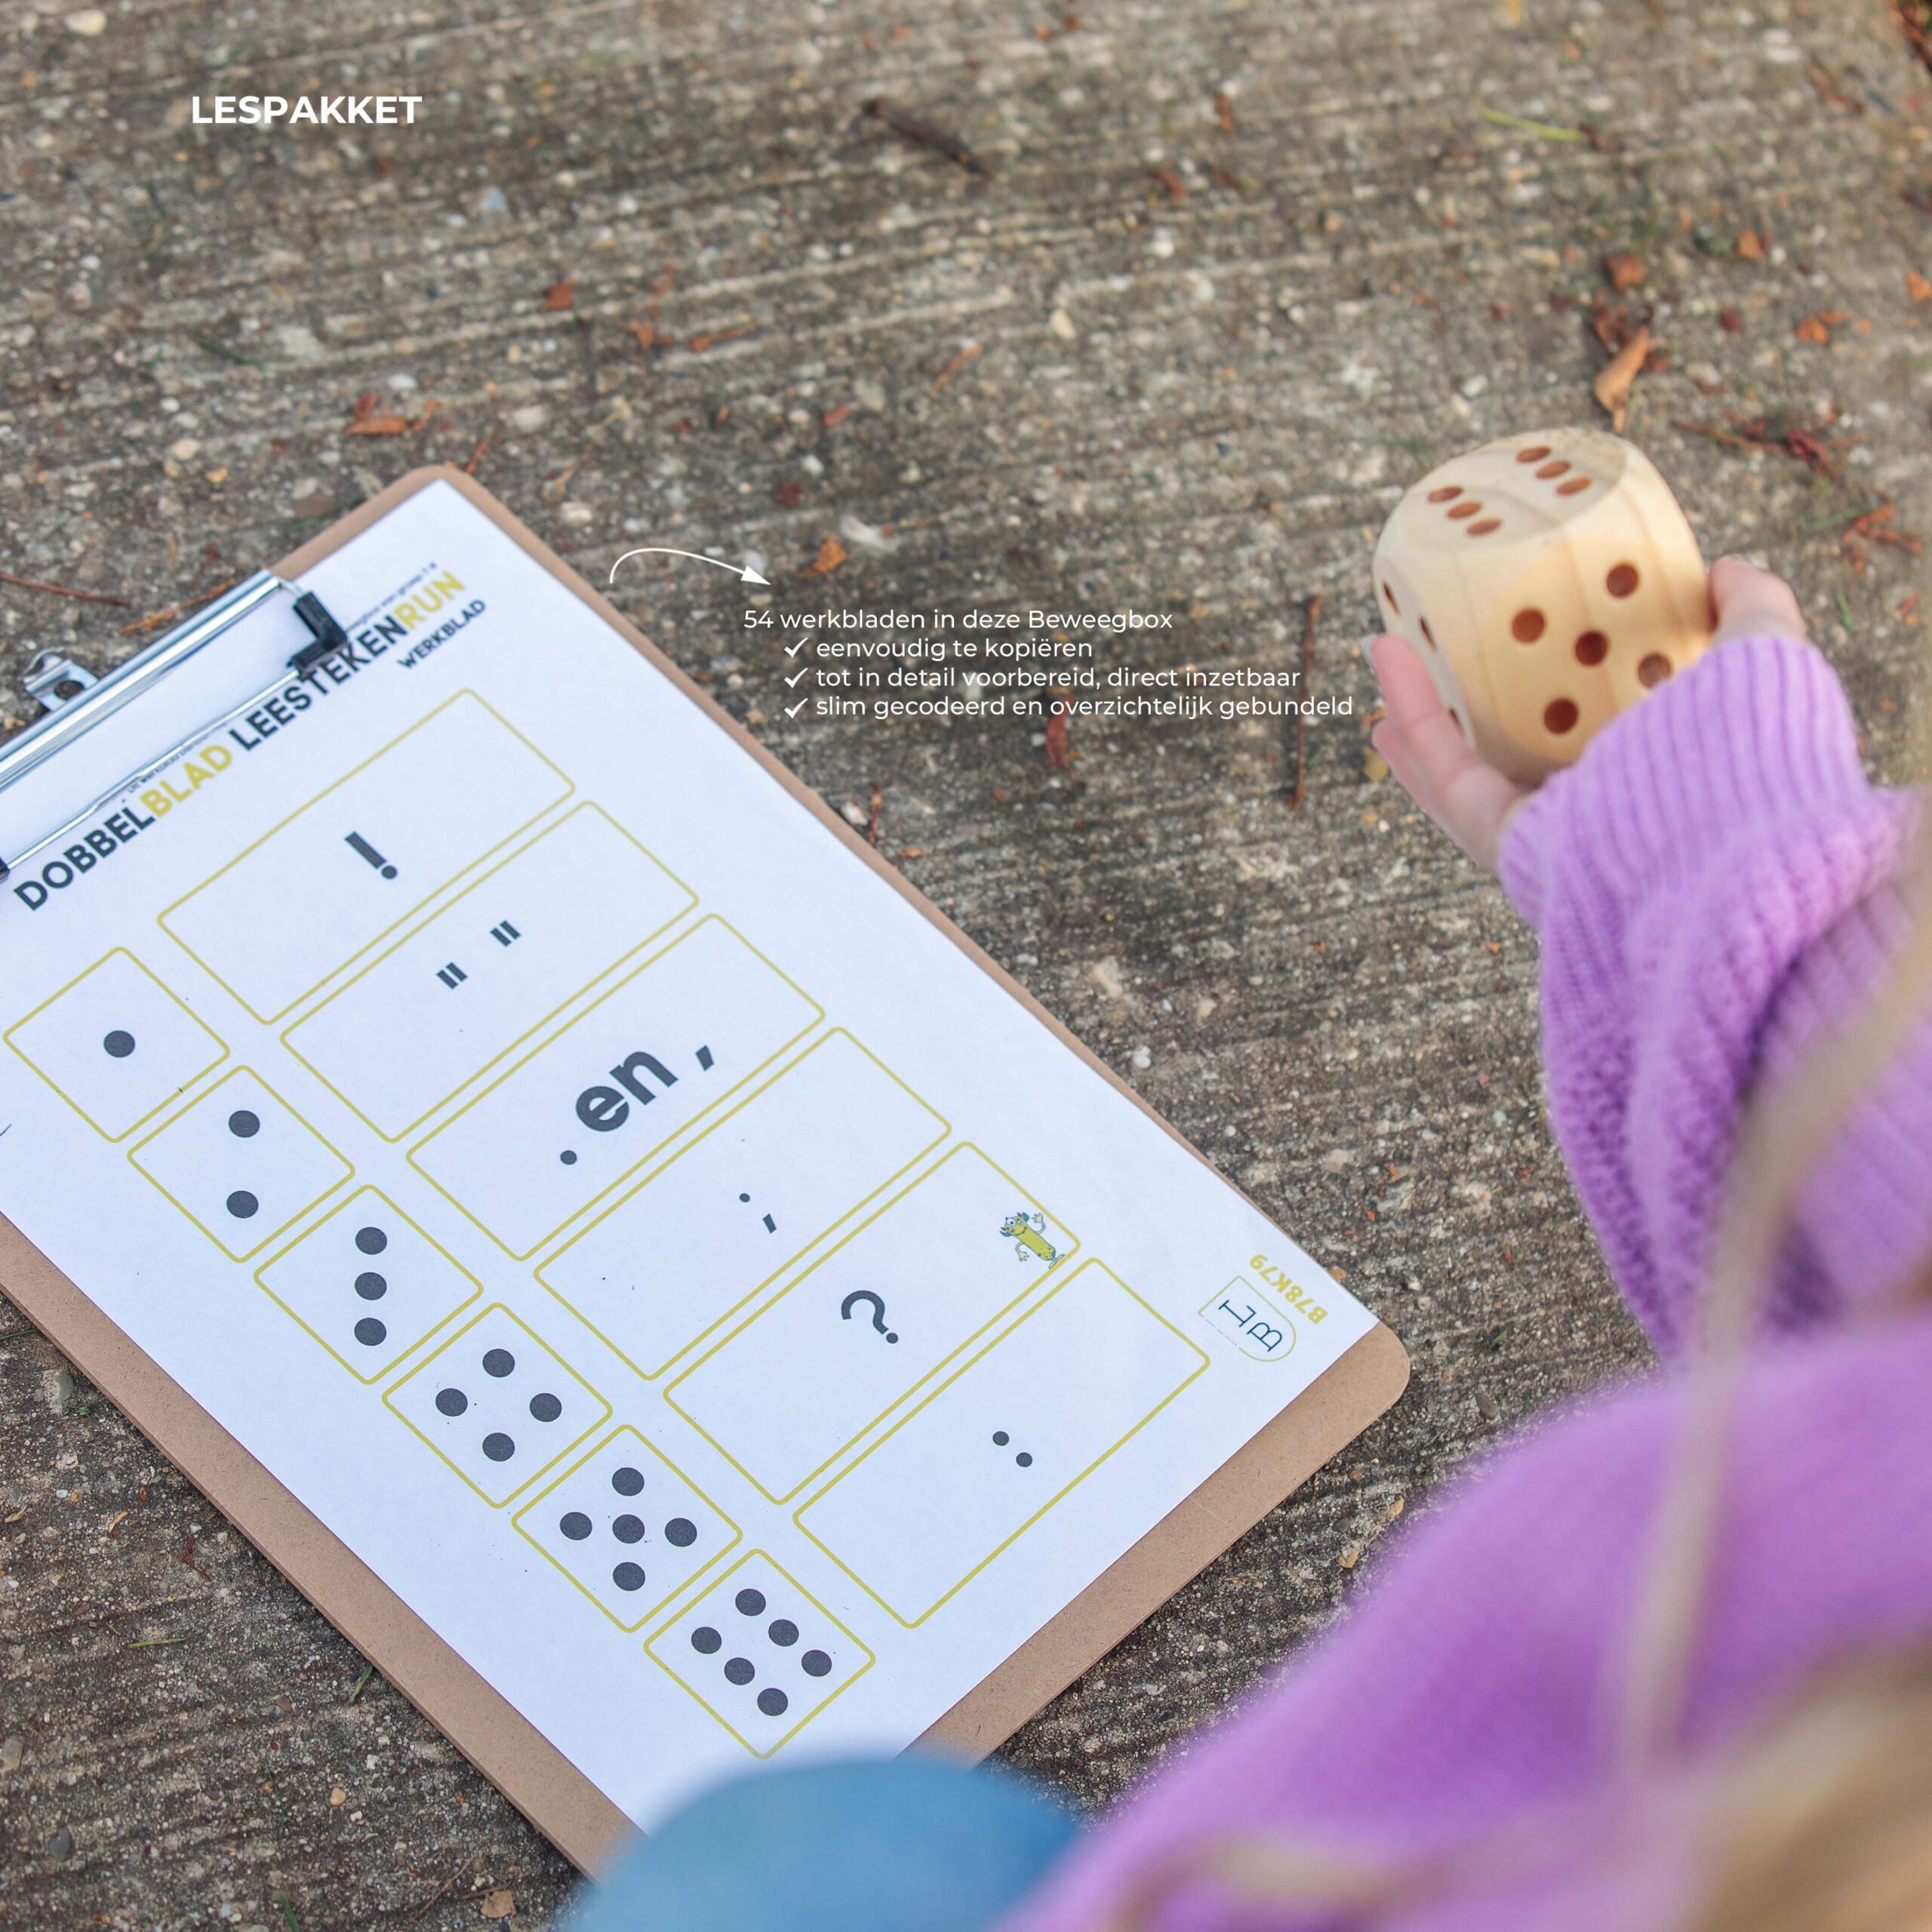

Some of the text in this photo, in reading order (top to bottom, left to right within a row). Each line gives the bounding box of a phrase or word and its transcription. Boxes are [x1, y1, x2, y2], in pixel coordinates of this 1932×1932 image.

[396, 598, 487, 670] WERKBLAD
[13, 744, 233, 911] DOBBELBLAD
[228, 570, 466, 752] LEESTEKENRUN
[343, 830, 399, 881] !
[575, 1051, 678, 1132] en
[840, 1289, 899, 1344] ?
[1249, 1254, 1328, 1325] B78K79
